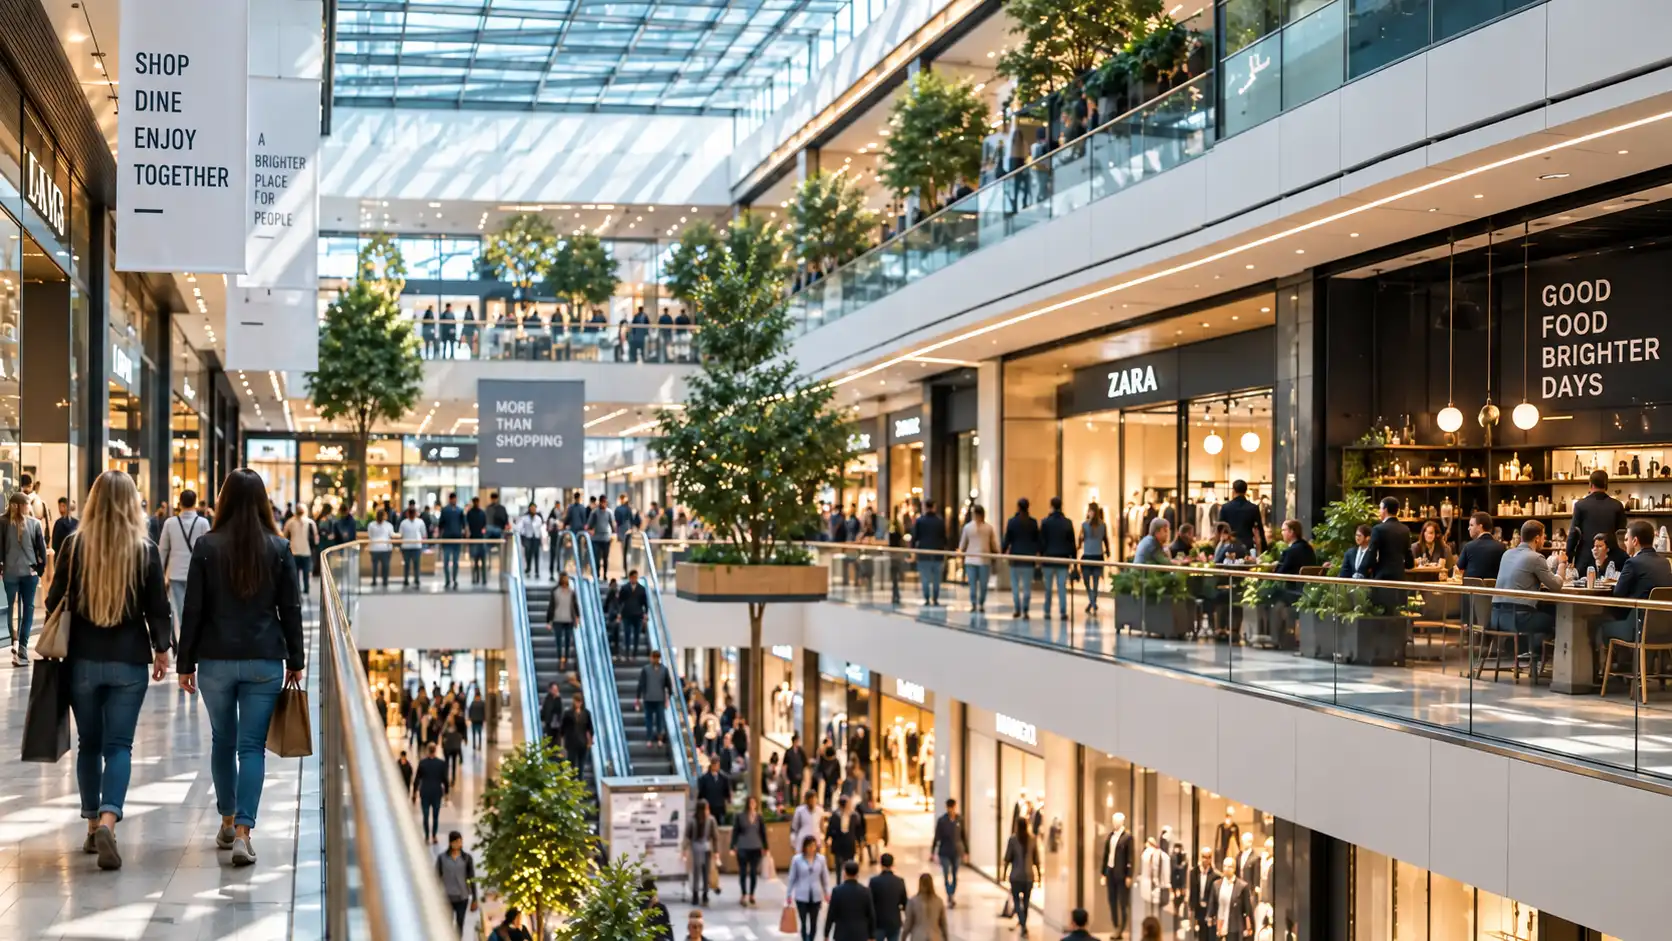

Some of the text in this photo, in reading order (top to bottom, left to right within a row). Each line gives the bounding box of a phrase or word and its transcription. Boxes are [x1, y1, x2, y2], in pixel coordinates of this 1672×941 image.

[136, 52, 189, 75] SHOP
[136, 90, 181, 112] DINE
[135, 127, 196, 150] ENJOY
[257, 132, 266, 147] A
[255, 155, 306, 170] BRIGHTER
[134, 164, 229, 188] TOGETHER
[255, 174, 287, 188] PLACE
[255, 190, 274, 204] FOR
[255, 210, 291, 227] PEOPLE
[1542, 279, 1611, 307] GOOD
[1542, 310, 1608, 338] FOOD
[1542, 337, 1660, 369] BRIGHTER
[1108, 366, 1157, 397] ZARA
[1542, 373, 1603, 399] DAYS
[497, 401, 534, 413] MORE
[497, 418, 531, 430] THAN
[497, 435, 562, 447] SHOPPING
